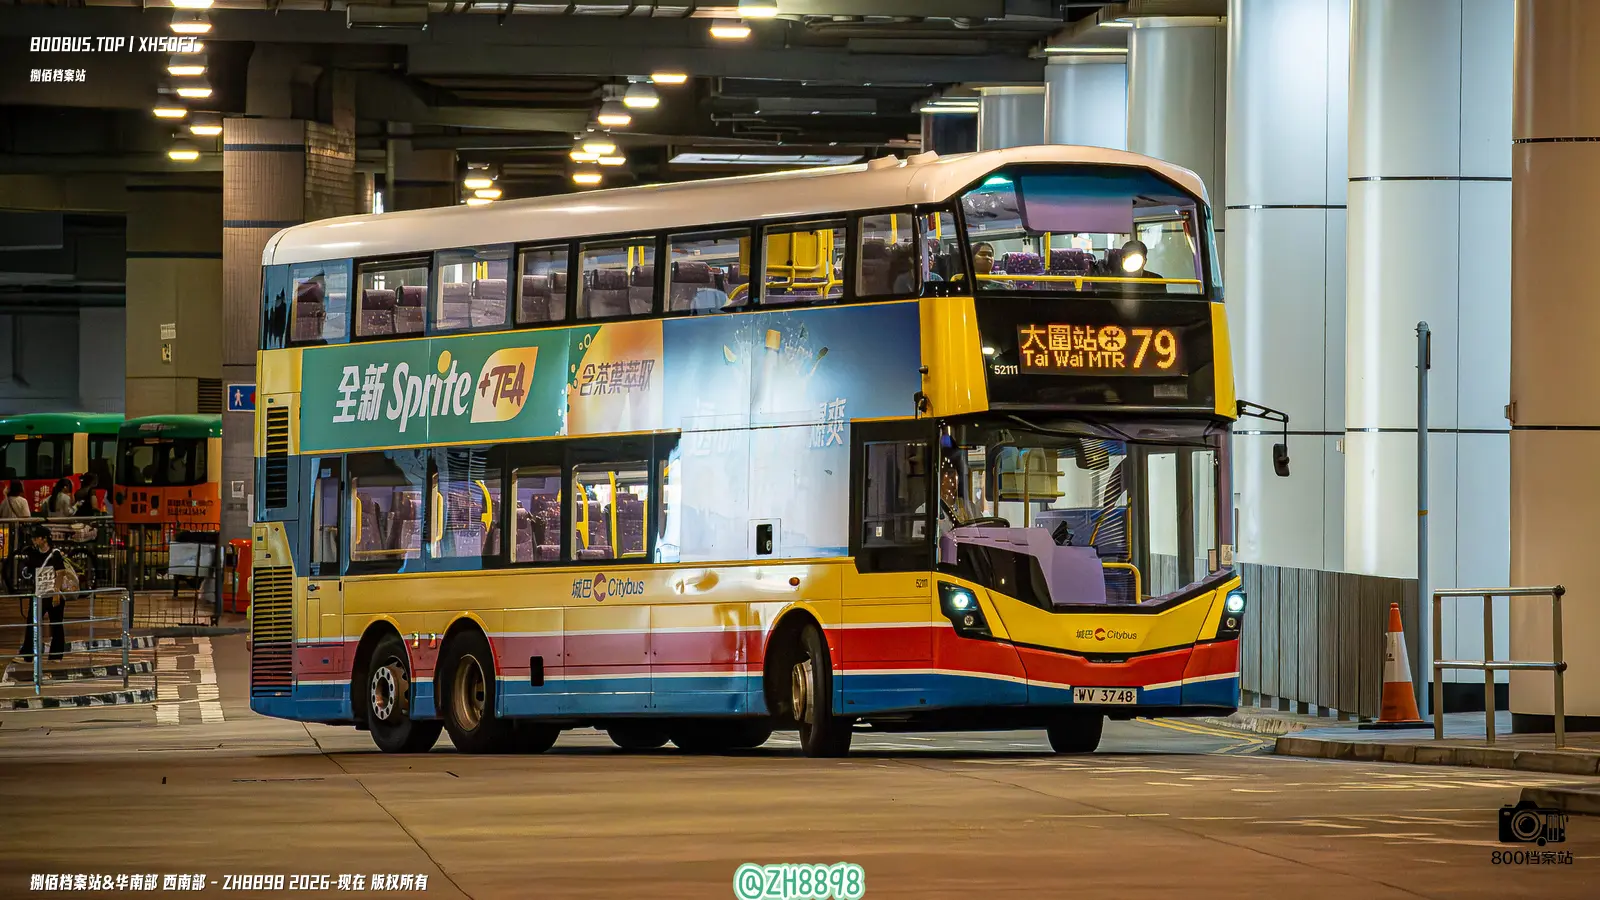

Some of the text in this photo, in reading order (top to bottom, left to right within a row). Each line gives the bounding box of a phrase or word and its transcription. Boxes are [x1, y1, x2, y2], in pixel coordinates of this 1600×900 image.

[1020, 324, 1177, 369] 大圍站 79
[1022, 350, 1126, 368] Tai Wai MTR
[580, 359, 655, 396] 含茶葉萃取
[994, 364, 1019, 375] 52111
[332, 363, 389, 423] 全新
[386, 350, 473, 432] Sprite
[571, 578, 644, 599] 城巴 Citybus
[1075, 628, 1137, 639] 城巴 Citybus
[1078, 688, 1133, 703] WV 3748
